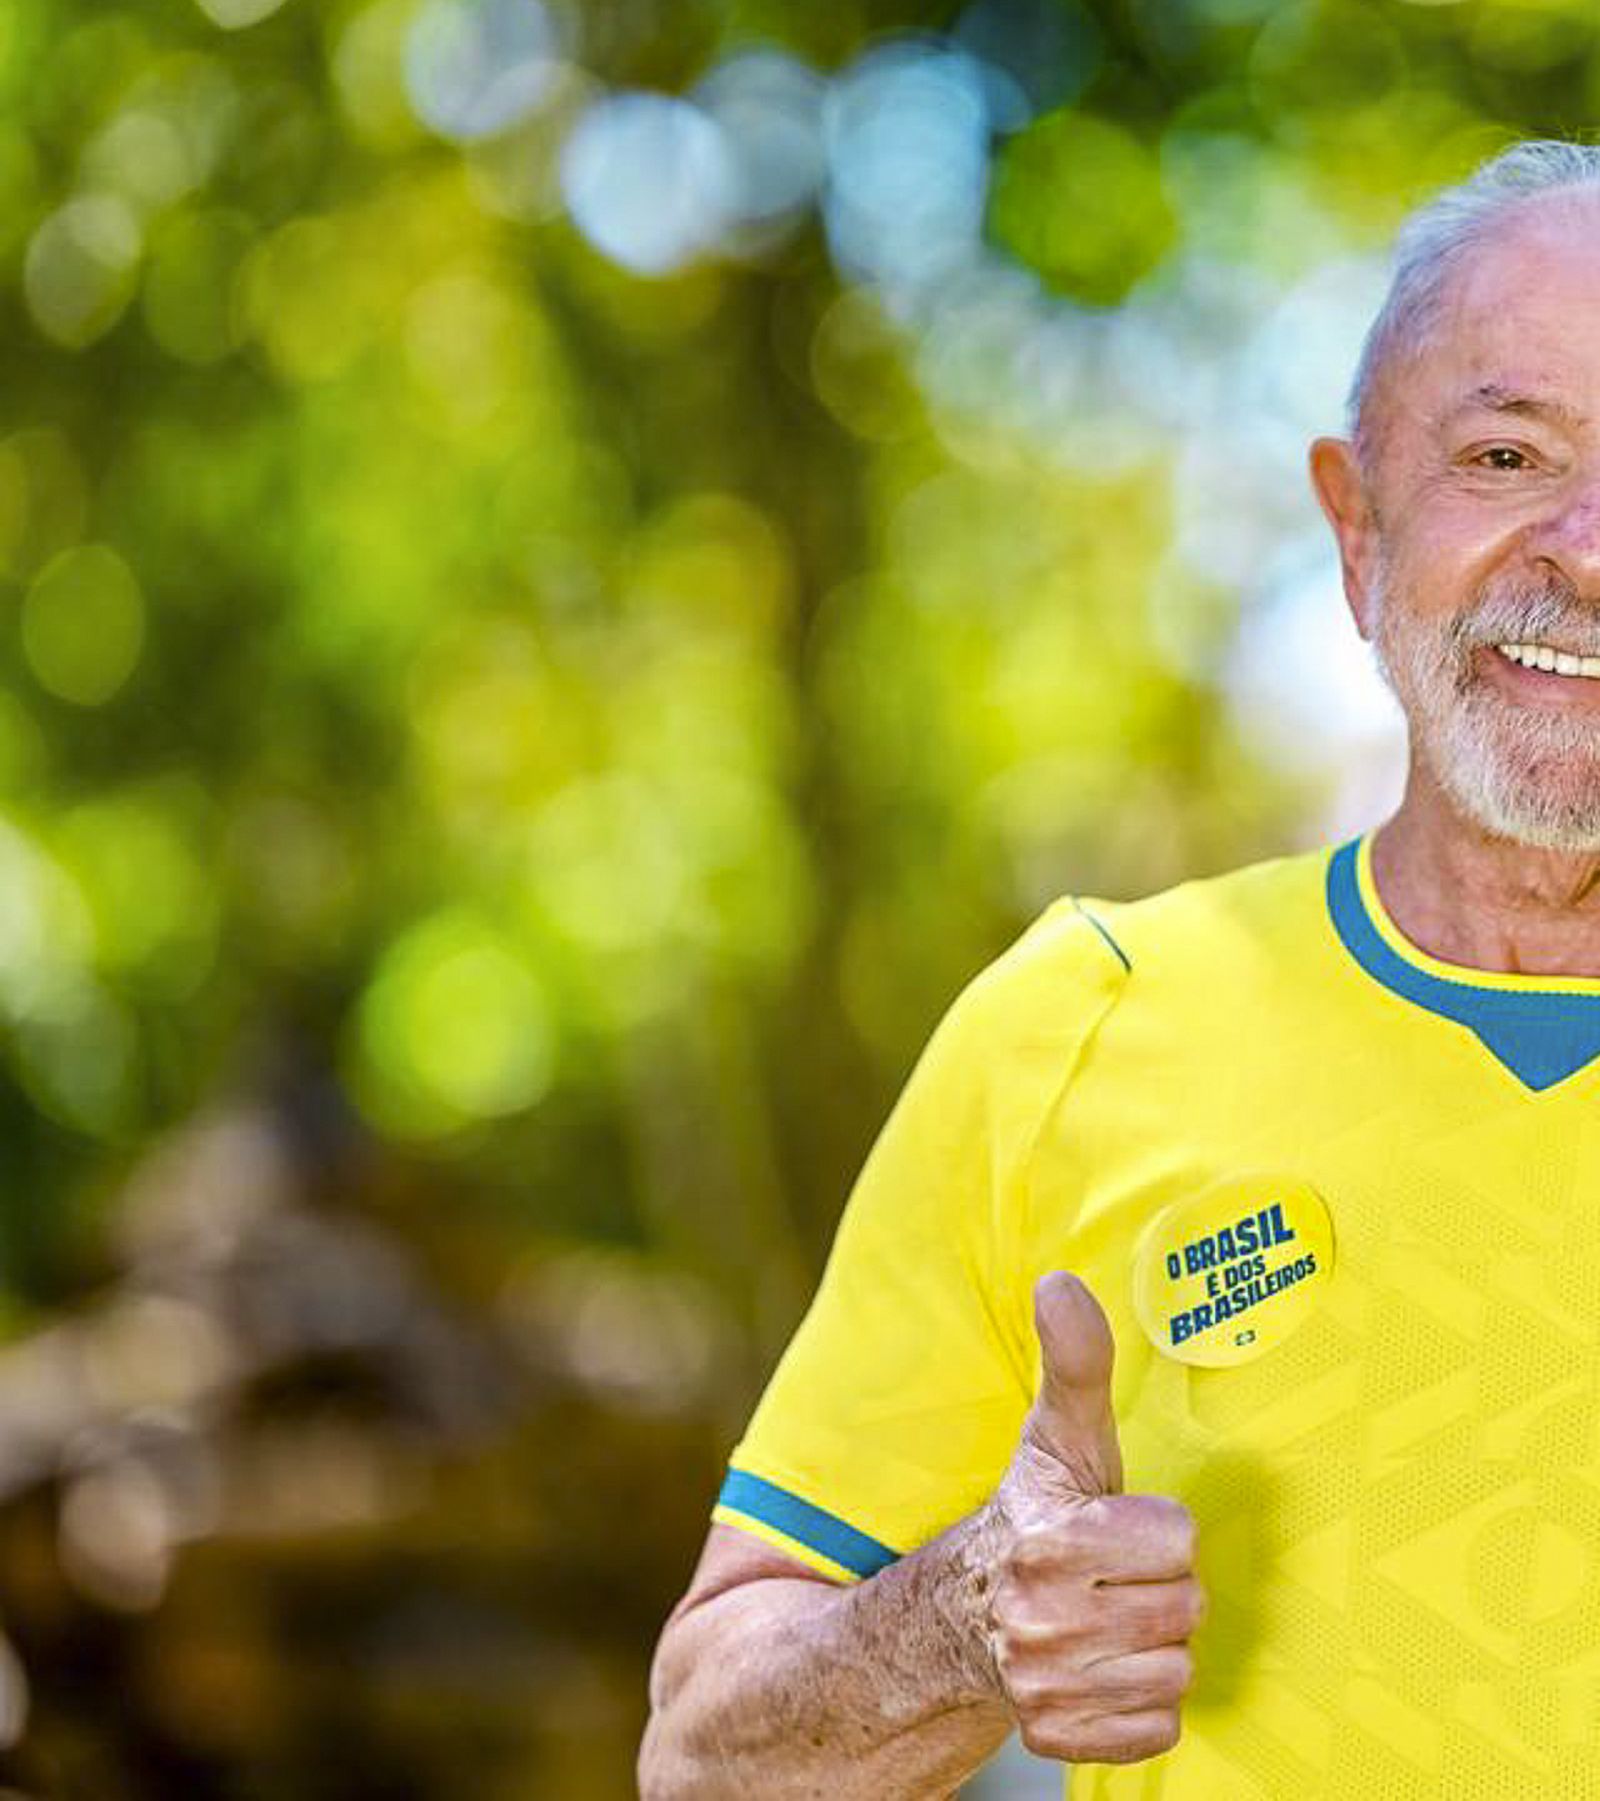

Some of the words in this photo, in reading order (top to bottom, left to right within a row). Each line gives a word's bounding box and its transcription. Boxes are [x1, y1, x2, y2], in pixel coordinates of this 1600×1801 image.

[1166, 1252, 1181, 1280] O
[1183, 1202, 1295, 1275] BRASIL
[1223, 1254, 1266, 1291] DOS
[1169, 1252, 1317, 1346] BRASILEIROS
